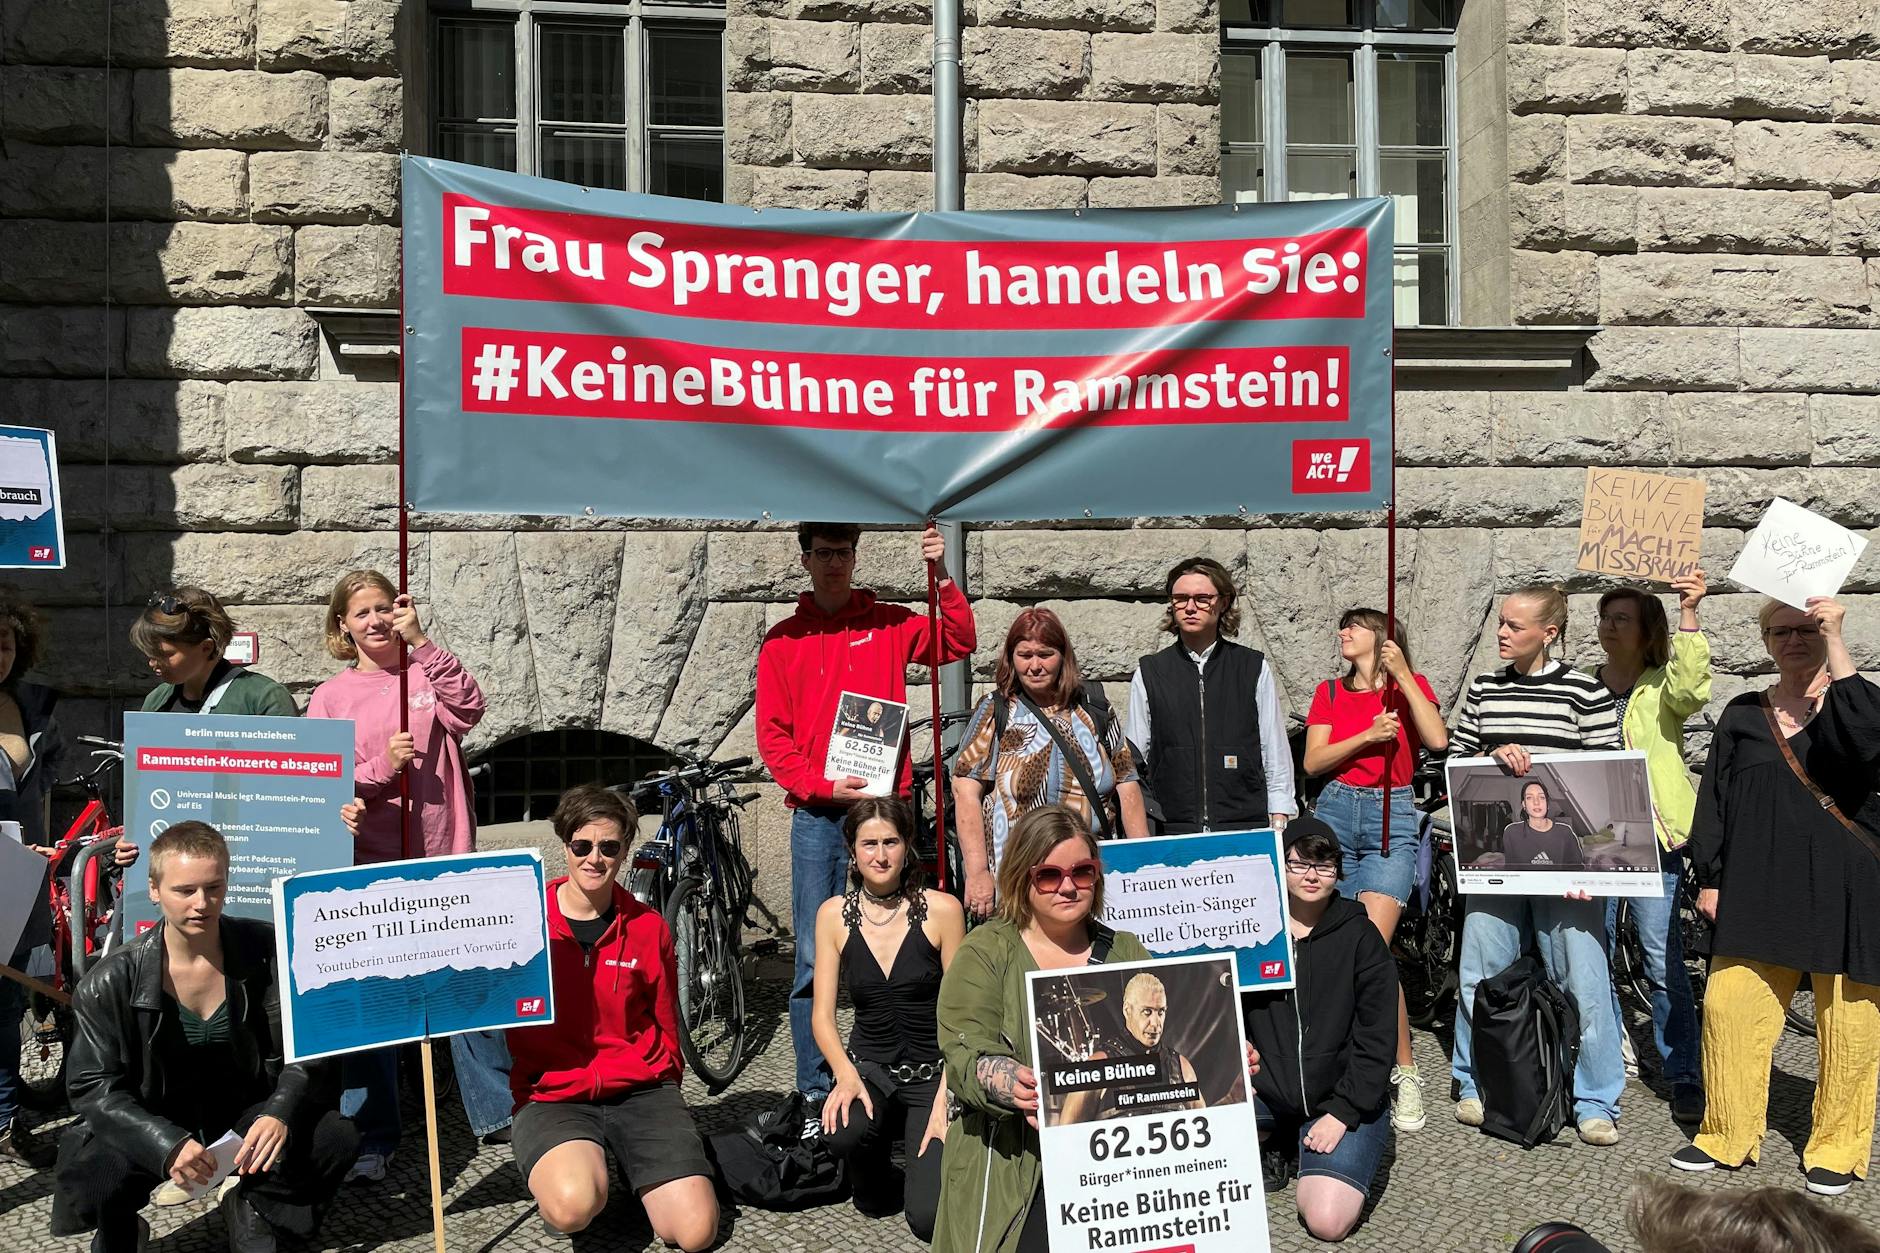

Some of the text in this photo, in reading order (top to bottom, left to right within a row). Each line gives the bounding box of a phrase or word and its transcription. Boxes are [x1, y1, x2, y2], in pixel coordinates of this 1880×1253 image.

[454, 206, 1361, 317] Frau Spranger, handeln Sie:
[472, 344, 1341, 417] #KeineBühne für Rammstein!
[1311, 452, 1333, 464] we
[1591, 471, 1690, 506] KEINE
[1600, 523, 1700, 557] MACHT-
[185, 728, 297, 741] Berlin muss nachziehen:
[845, 739, 883, 756] 62.563
[142, 753, 338, 774] Rammstein-Konzerte absagen!
[831, 755, 890, 775] Keine Bühne für
[836, 764, 881, 779] Rammstein!
[177, 790, 326, 804] Universal Music legt Rammstein-Promo
[177, 801, 202, 810] auf Eis
[222, 823, 254, 832] beendet
[255, 824, 320, 835] Zusammenarbeit
[252, 855, 281, 864] Podcast
[269, 867, 296, 875] "Flake"
[1122, 870, 1234, 894] Frauen werfen
[237, 896, 271, 904] Konzerte
[313, 893, 471, 923] Anschuldigungen
[1106, 896, 1257, 922] Rammstein-Sänger
[314, 914, 515, 952] gegen Till Lindemann:
[1177, 918, 1261, 941] Übergriffe
[316, 939, 518, 975] Youtuberin untermauert Vorwürfe
[1054, 1063, 1156, 1087] Keine Bühne
[1118, 1087, 1195, 1106] für Rammstein
[1089, 1116, 1212, 1162] 62.563
[1174, 1158, 1227, 1178] meinen:
[1060, 1179, 1252, 1226] Keine Bühne für
[1088, 1208, 1231, 1250] Rammstein!
